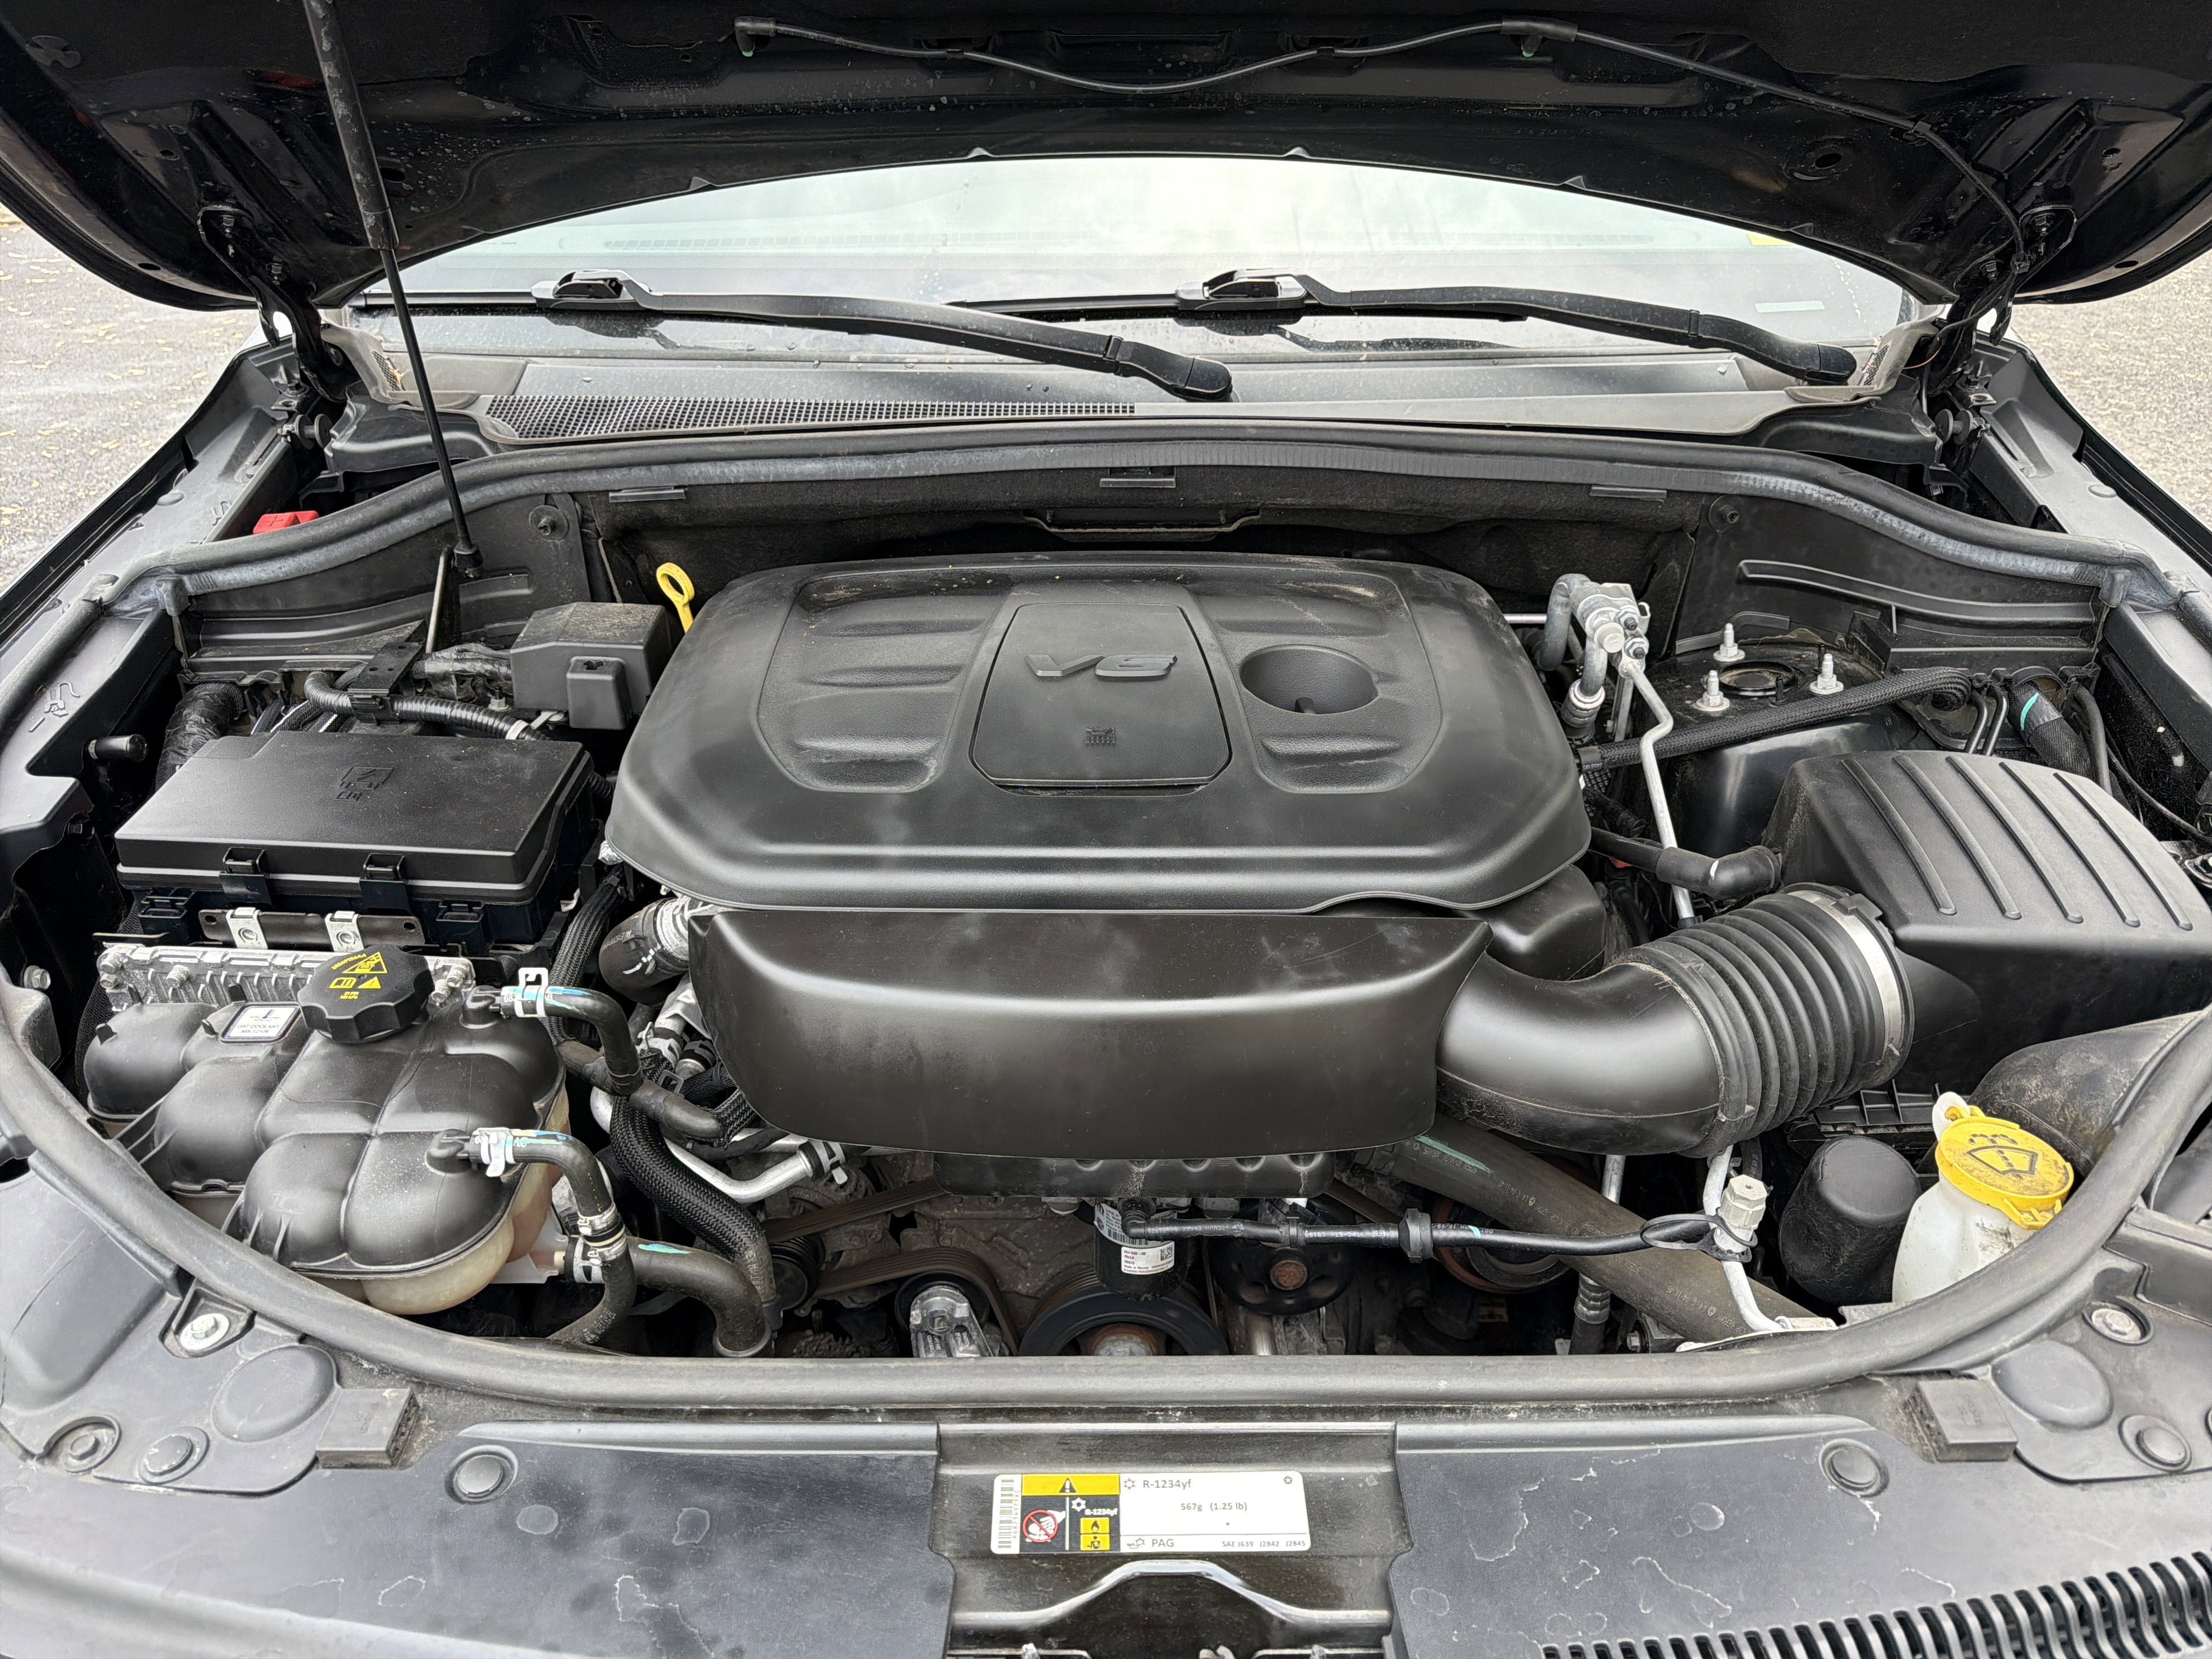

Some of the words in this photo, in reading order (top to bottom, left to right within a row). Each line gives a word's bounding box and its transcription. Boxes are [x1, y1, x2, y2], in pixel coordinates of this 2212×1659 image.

[1024, 654, 1178, 680] V6
[1142, 1479, 1192, 1489] R-1234yf
[1181, 1502, 1203, 1511] 567g
[1210, 1502, 1232, 1511] (1.25
[1234, 1502, 1248, 1511] lb)
[1151, 1538, 1175, 1548] PAG
